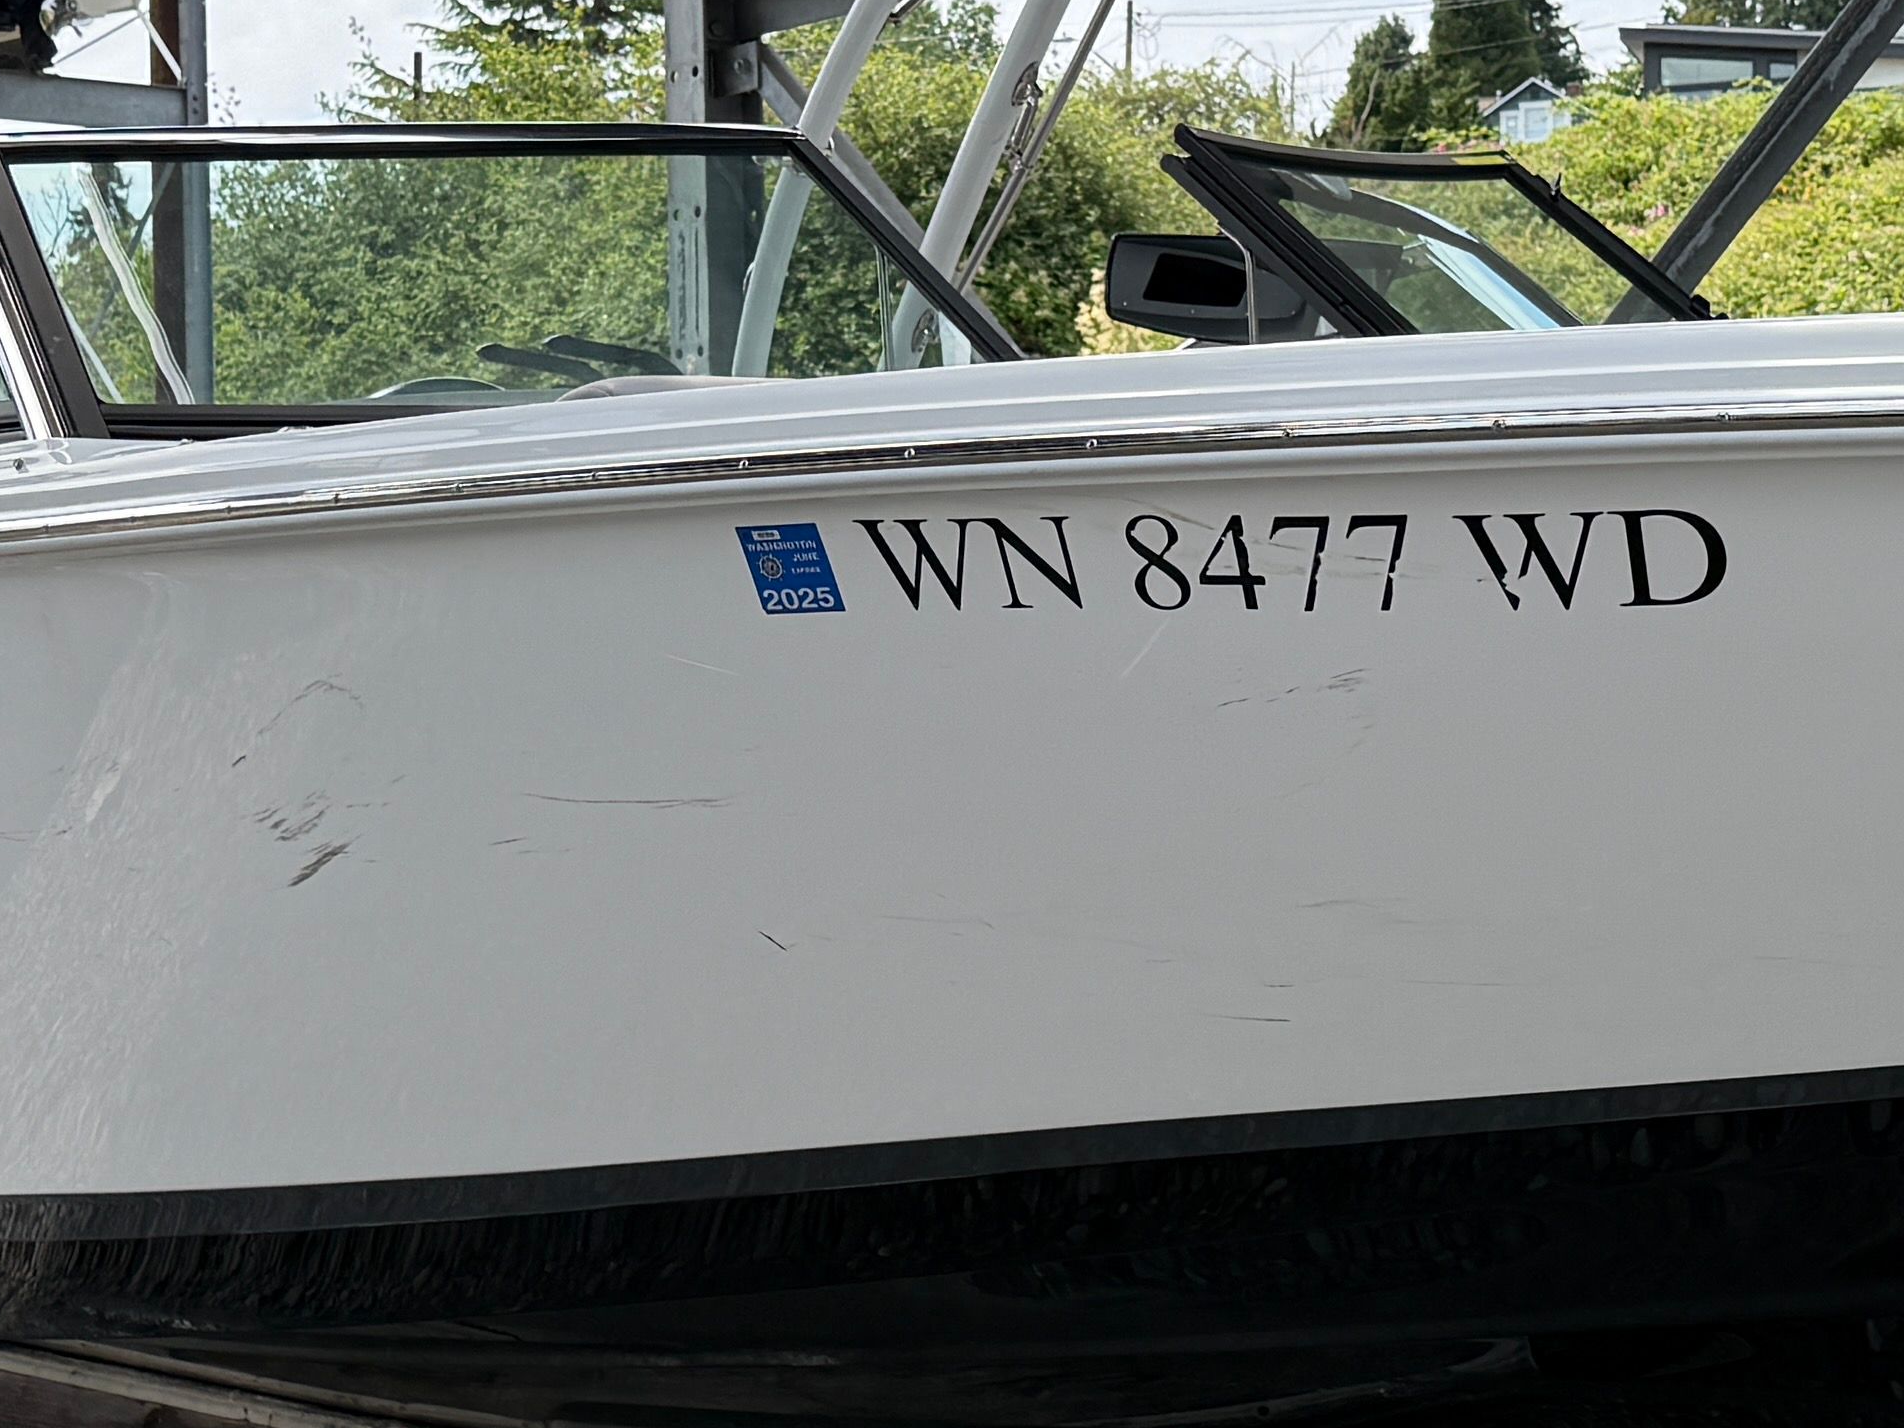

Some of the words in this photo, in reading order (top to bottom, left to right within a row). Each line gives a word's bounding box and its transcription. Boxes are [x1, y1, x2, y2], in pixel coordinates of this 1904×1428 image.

[852, 515, 1083, 612] WN
[1125, 514, 1408, 612] 8477
[1452, 509, 1727, 612] WD
[762, 587, 835, 610] 2025
